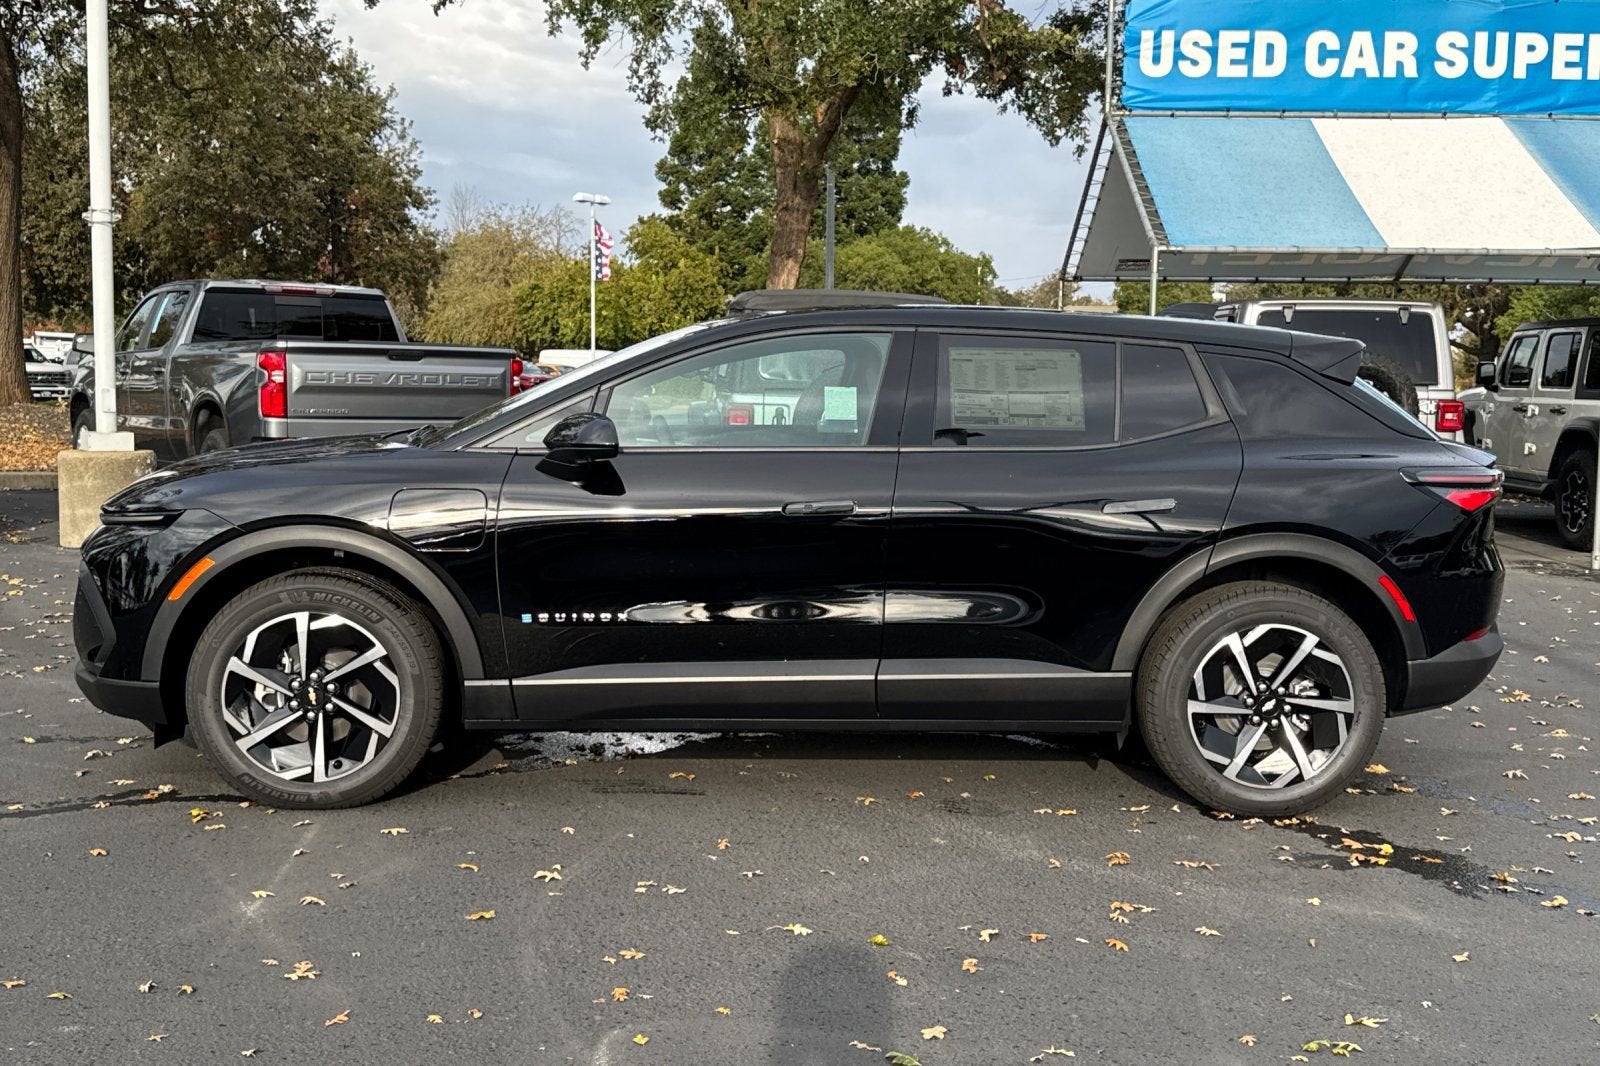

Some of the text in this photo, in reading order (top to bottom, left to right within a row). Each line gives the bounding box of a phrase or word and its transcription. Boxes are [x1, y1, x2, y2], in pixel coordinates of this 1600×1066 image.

[1139, 29, 1288, 78] USED
[1304, 29, 1419, 78] CAR
[305, 371, 499, 387] CHEVROLET
[312, 591, 381, 621] MICHELIN
[241, 773, 308, 803] MICHELIN
